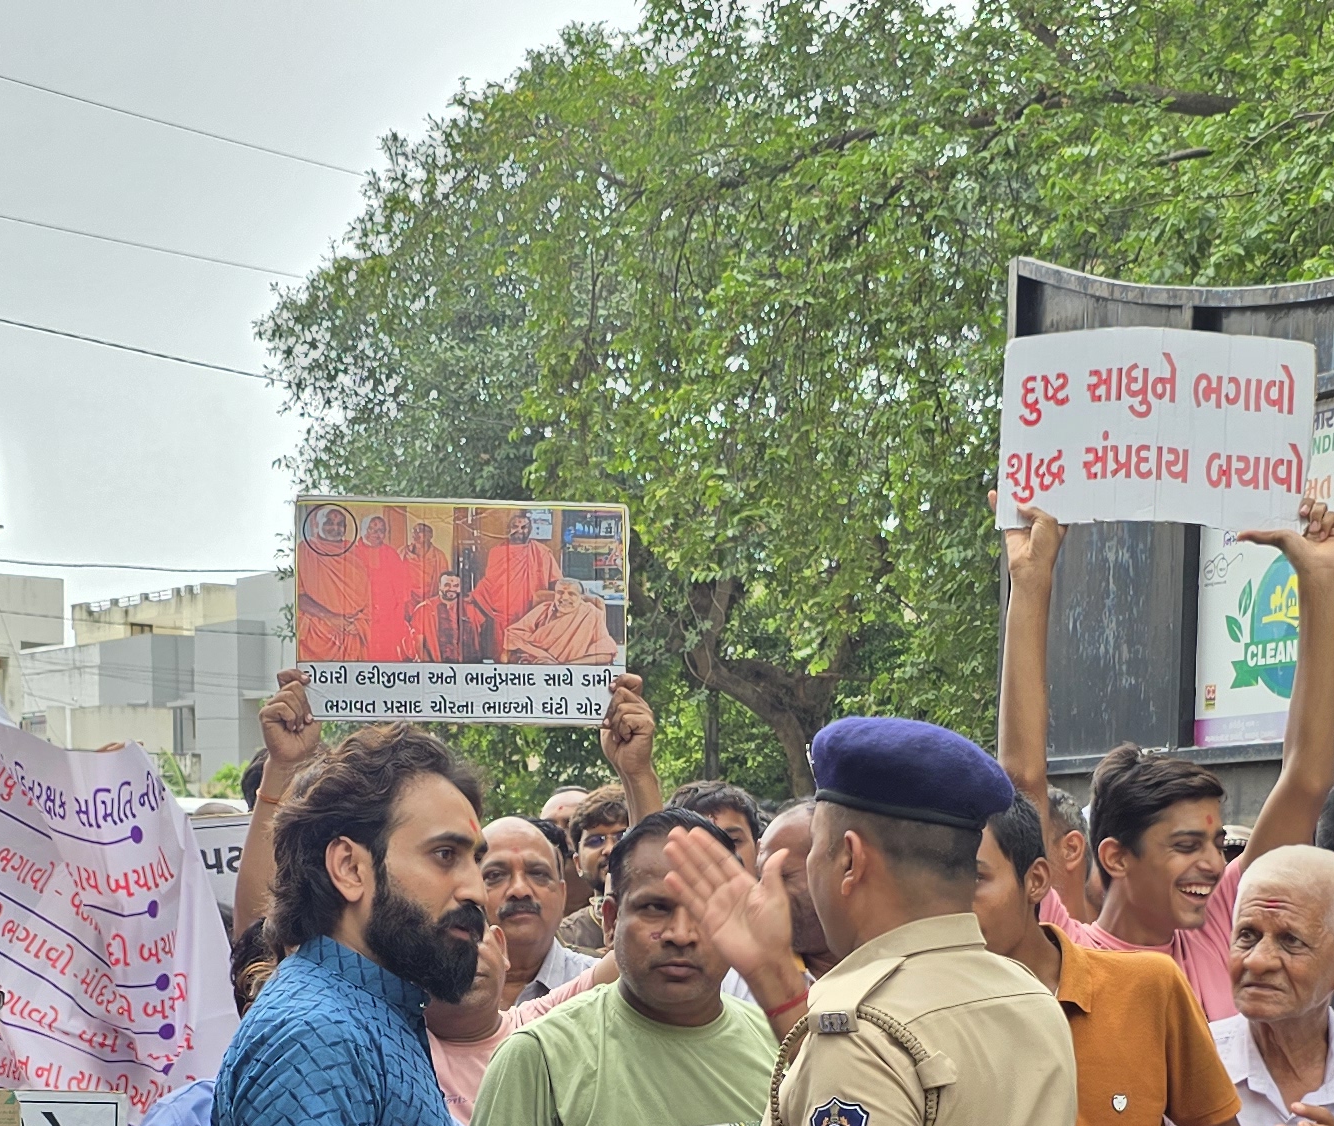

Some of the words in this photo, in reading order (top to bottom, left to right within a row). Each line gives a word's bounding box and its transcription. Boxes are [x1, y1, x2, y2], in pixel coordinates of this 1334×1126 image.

[1018, 369, 1070, 427] દુષ્ટ
[1086, 352, 1177, 419] સાધુને
[1193, 364, 1296, 416] ભગાવો
[1082, 430, 1189, 485] સંપ્રદાય
[1205, 443, 1304, 495] બચાવો
[1246, 639, 1298, 667] CLEAN
[428, 667, 457, 685] અને
[465, 667, 536, 692] ભાનુંપ્રસાદ
[543, 668, 573, 688] સાથે
[581, 669, 618, 687] ડામી
[325, 699, 376, 714] ભગવત
[383, 699, 423, 714] પ્રસાદ
[430, 695, 474, 715] ચોરના
[482, 696, 534, 716] ભાઇઓ
[541, 696, 568, 716] ઘંટી
[576, 697, 602, 717] ચોર
[75, 781, 137, 829] સમિતિ
[2, 919, 75, 976] ભગાવો
